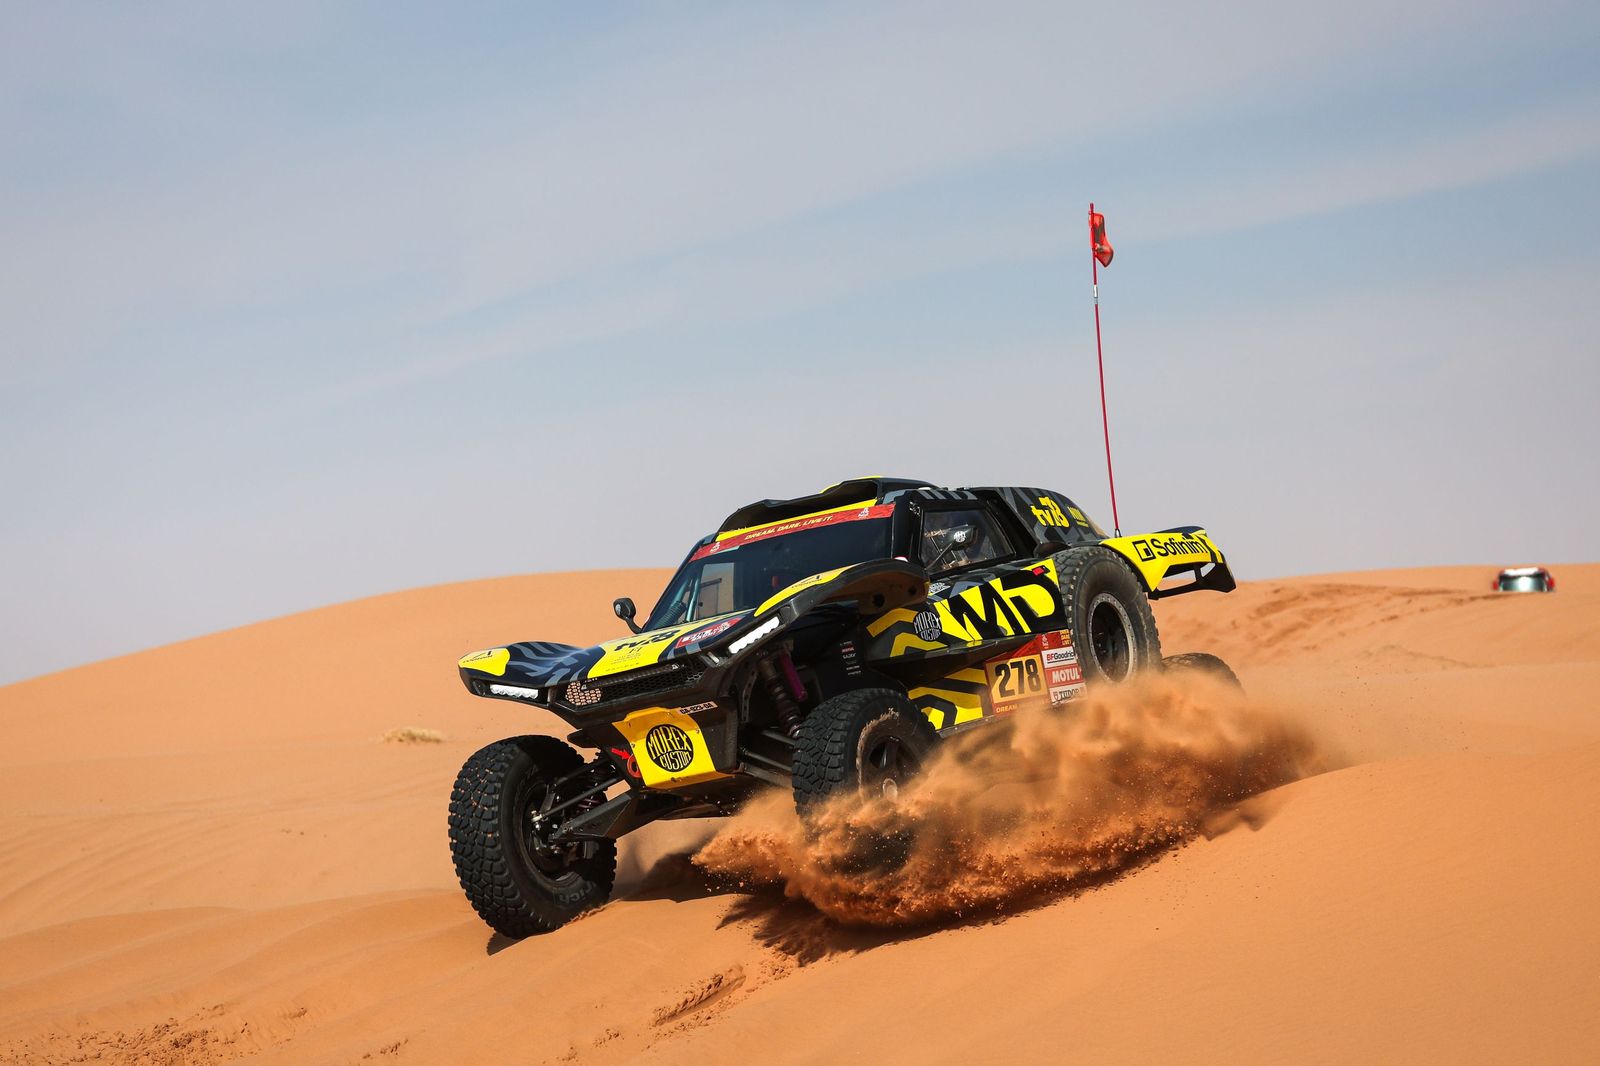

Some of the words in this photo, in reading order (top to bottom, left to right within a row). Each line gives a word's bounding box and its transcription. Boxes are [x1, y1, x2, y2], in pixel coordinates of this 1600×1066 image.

[777, 522, 801, 533] DARE.
[1150, 536, 1209, 557] Sofinim
[914, 610, 942, 634] MOREX
[995, 658, 1042, 699] 278
[1052, 667, 1080, 684] MOTUL
[647, 725, 693, 760] MOREX
[659, 750, 692, 771] CUSTOM
